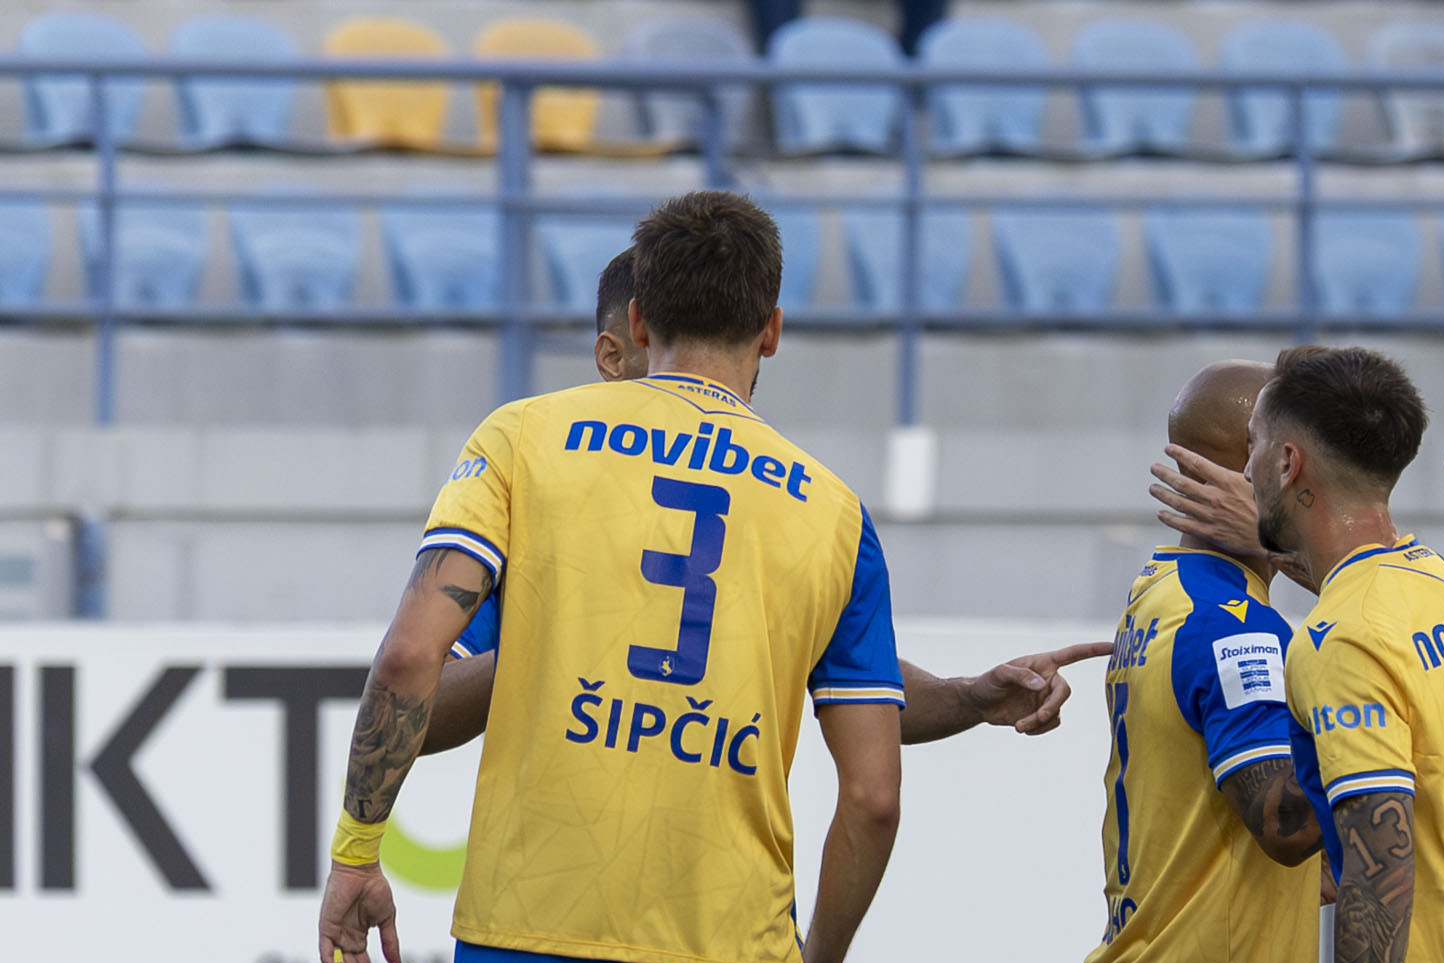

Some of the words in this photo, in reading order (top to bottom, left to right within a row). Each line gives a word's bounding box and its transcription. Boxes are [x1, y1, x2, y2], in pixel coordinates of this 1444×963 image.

[564, 420, 811, 502] novibet
[626, 475, 731, 687] 3
[1220, 644, 1279, 661] Stoiximan
[565, 677, 761, 776] ŠIPČIĆ
[1308, 702, 1387, 735] lton
